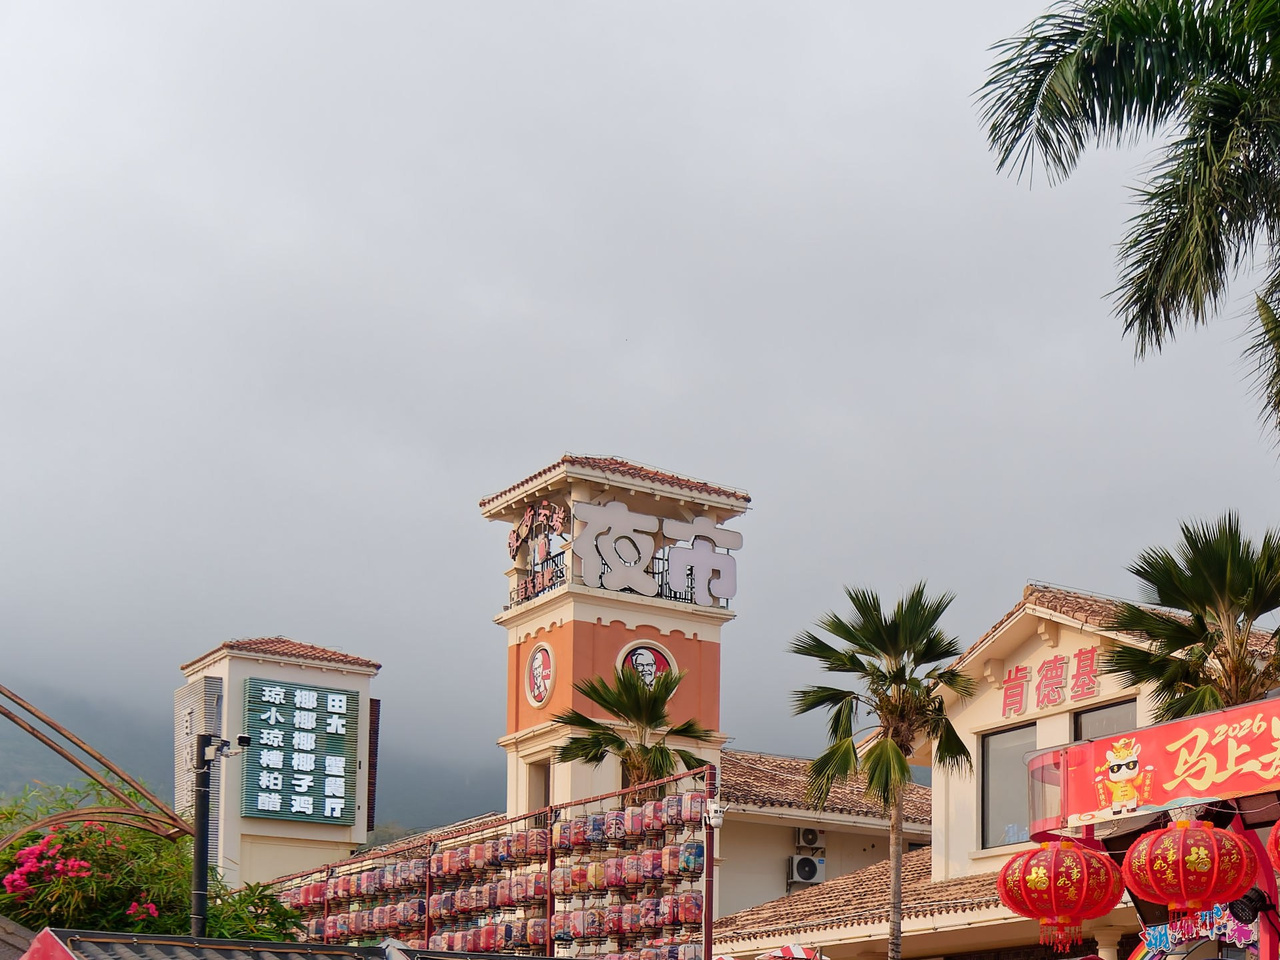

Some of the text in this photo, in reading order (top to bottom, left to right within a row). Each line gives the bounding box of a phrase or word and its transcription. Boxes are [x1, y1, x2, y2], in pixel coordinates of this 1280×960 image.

[572, 501, 743, 608] 夜市
[1002, 646, 1099, 718] 肯德基
[257, 686, 286, 811] 琼小琼糟粕醋
[291, 689, 318, 814] 椰椰椰椰子鸡
[1211, 713, 1266, 744] 2026
[1026, 866, 1049, 890] 福
[1185, 847, 1212, 872] 福
